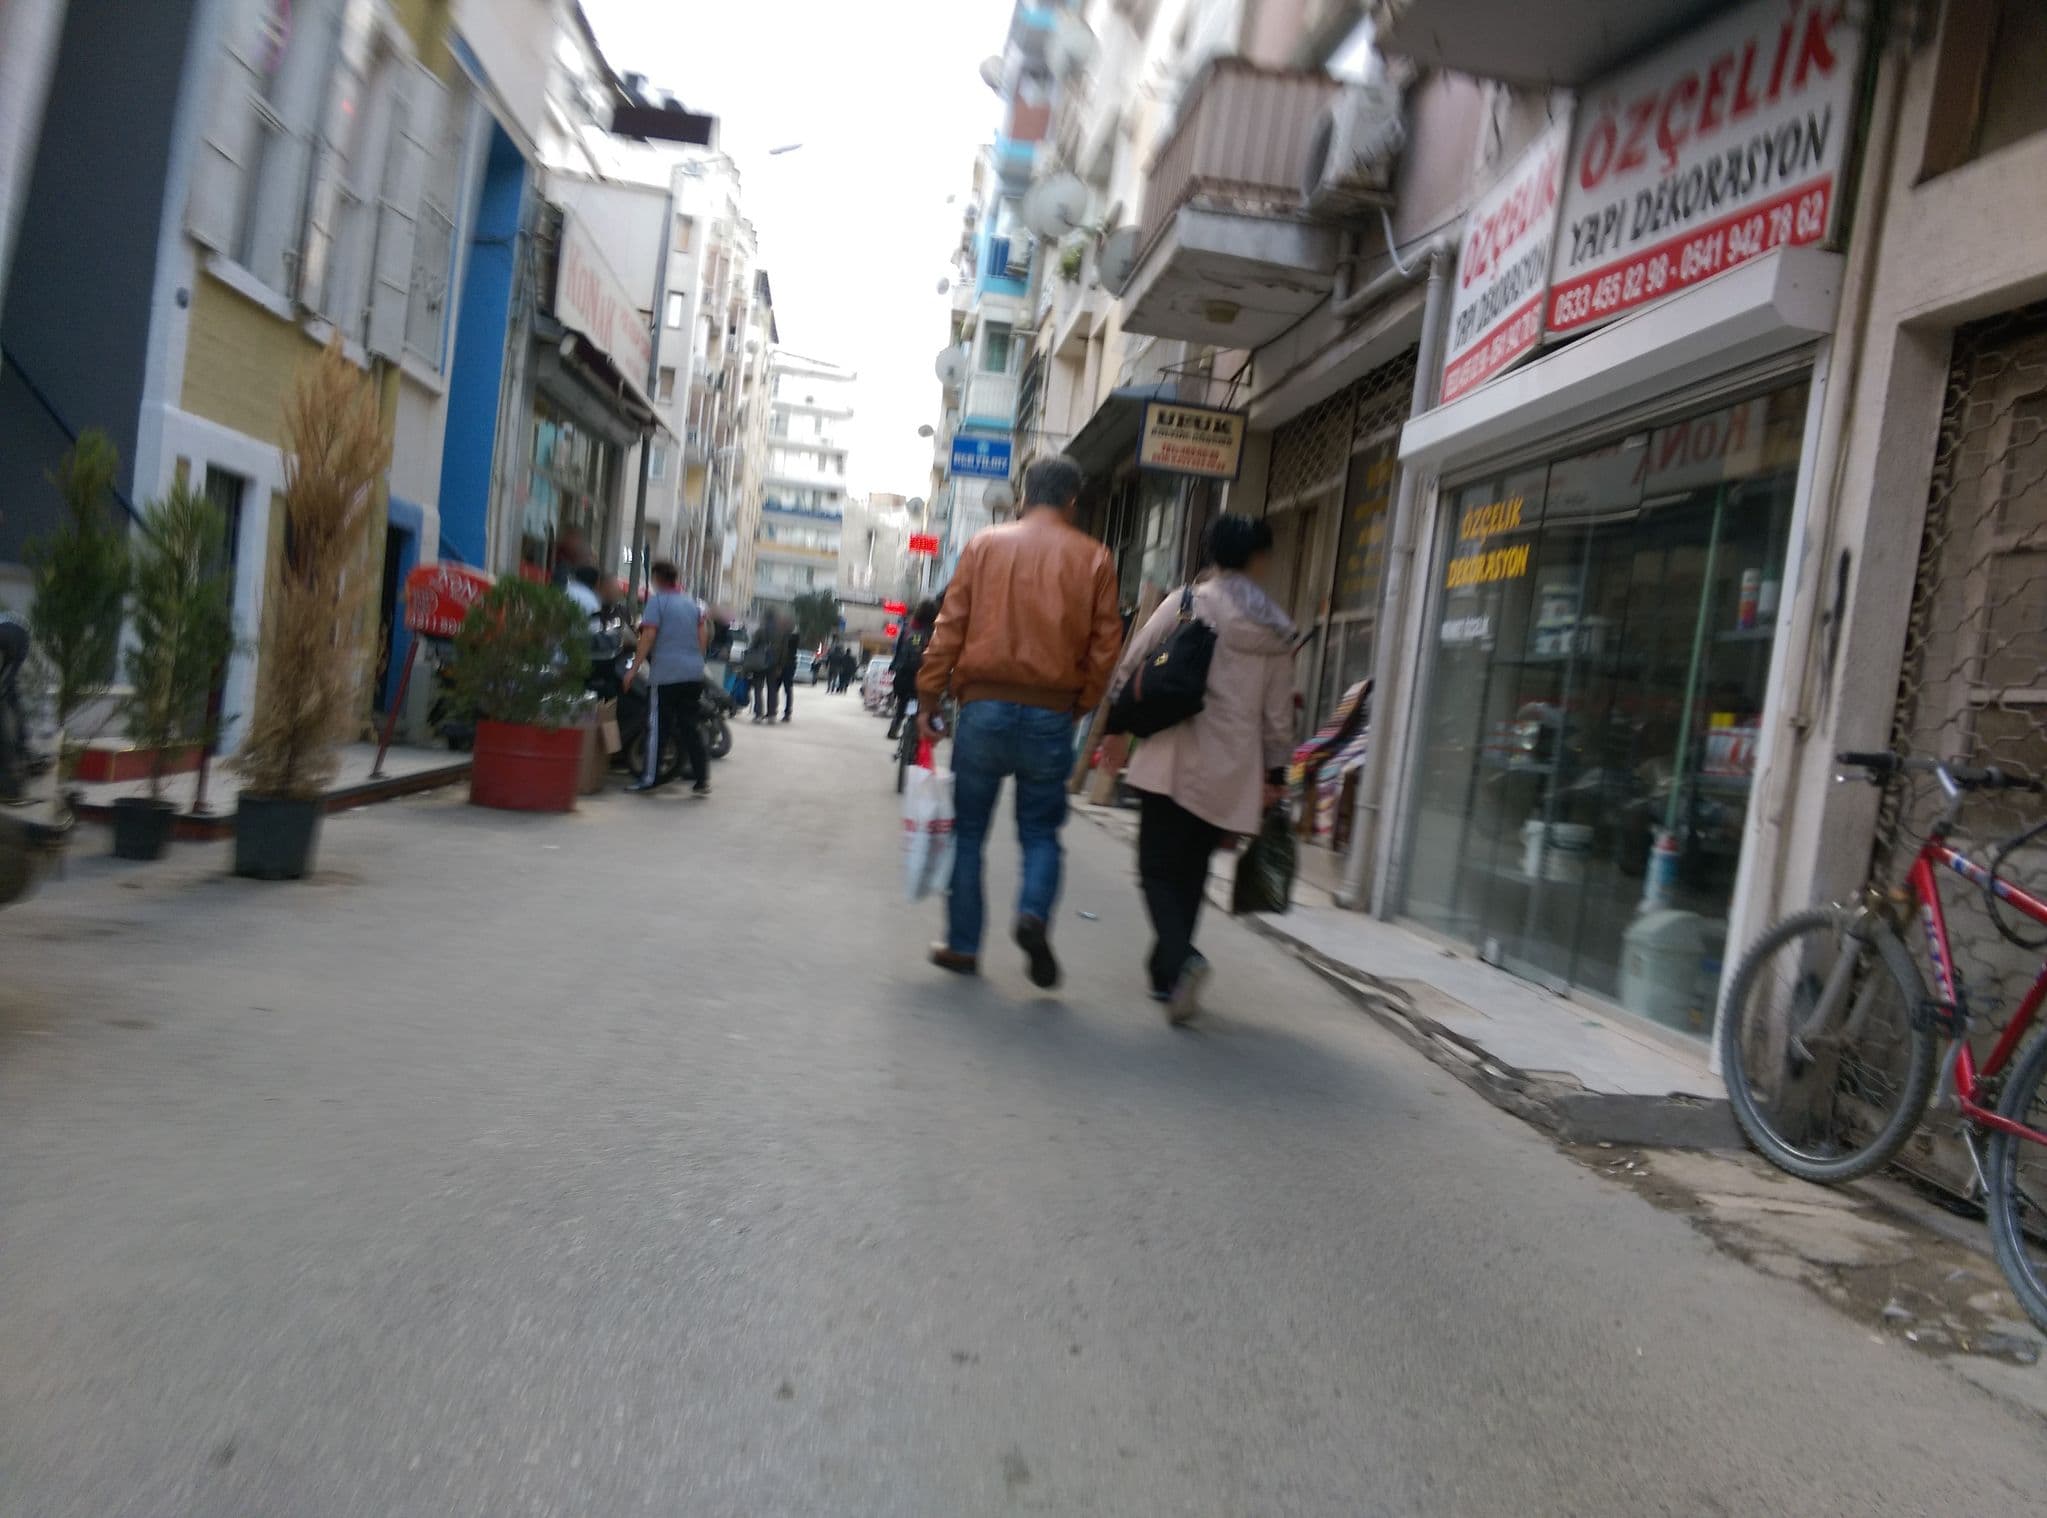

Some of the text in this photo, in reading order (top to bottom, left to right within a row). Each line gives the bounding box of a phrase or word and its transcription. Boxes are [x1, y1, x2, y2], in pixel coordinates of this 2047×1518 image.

[1579, 0, 1846, 191] ÖZÇELİK
[1568, 104, 1833, 267] YAPI DEKORASYON
[1554, 284, 1592, 326] 0533
[1680, 229, 1724, 280] 0541
[1726, 214, 1765, 263] 942
[1446, 543, 1531, 589] DEKORASYON
